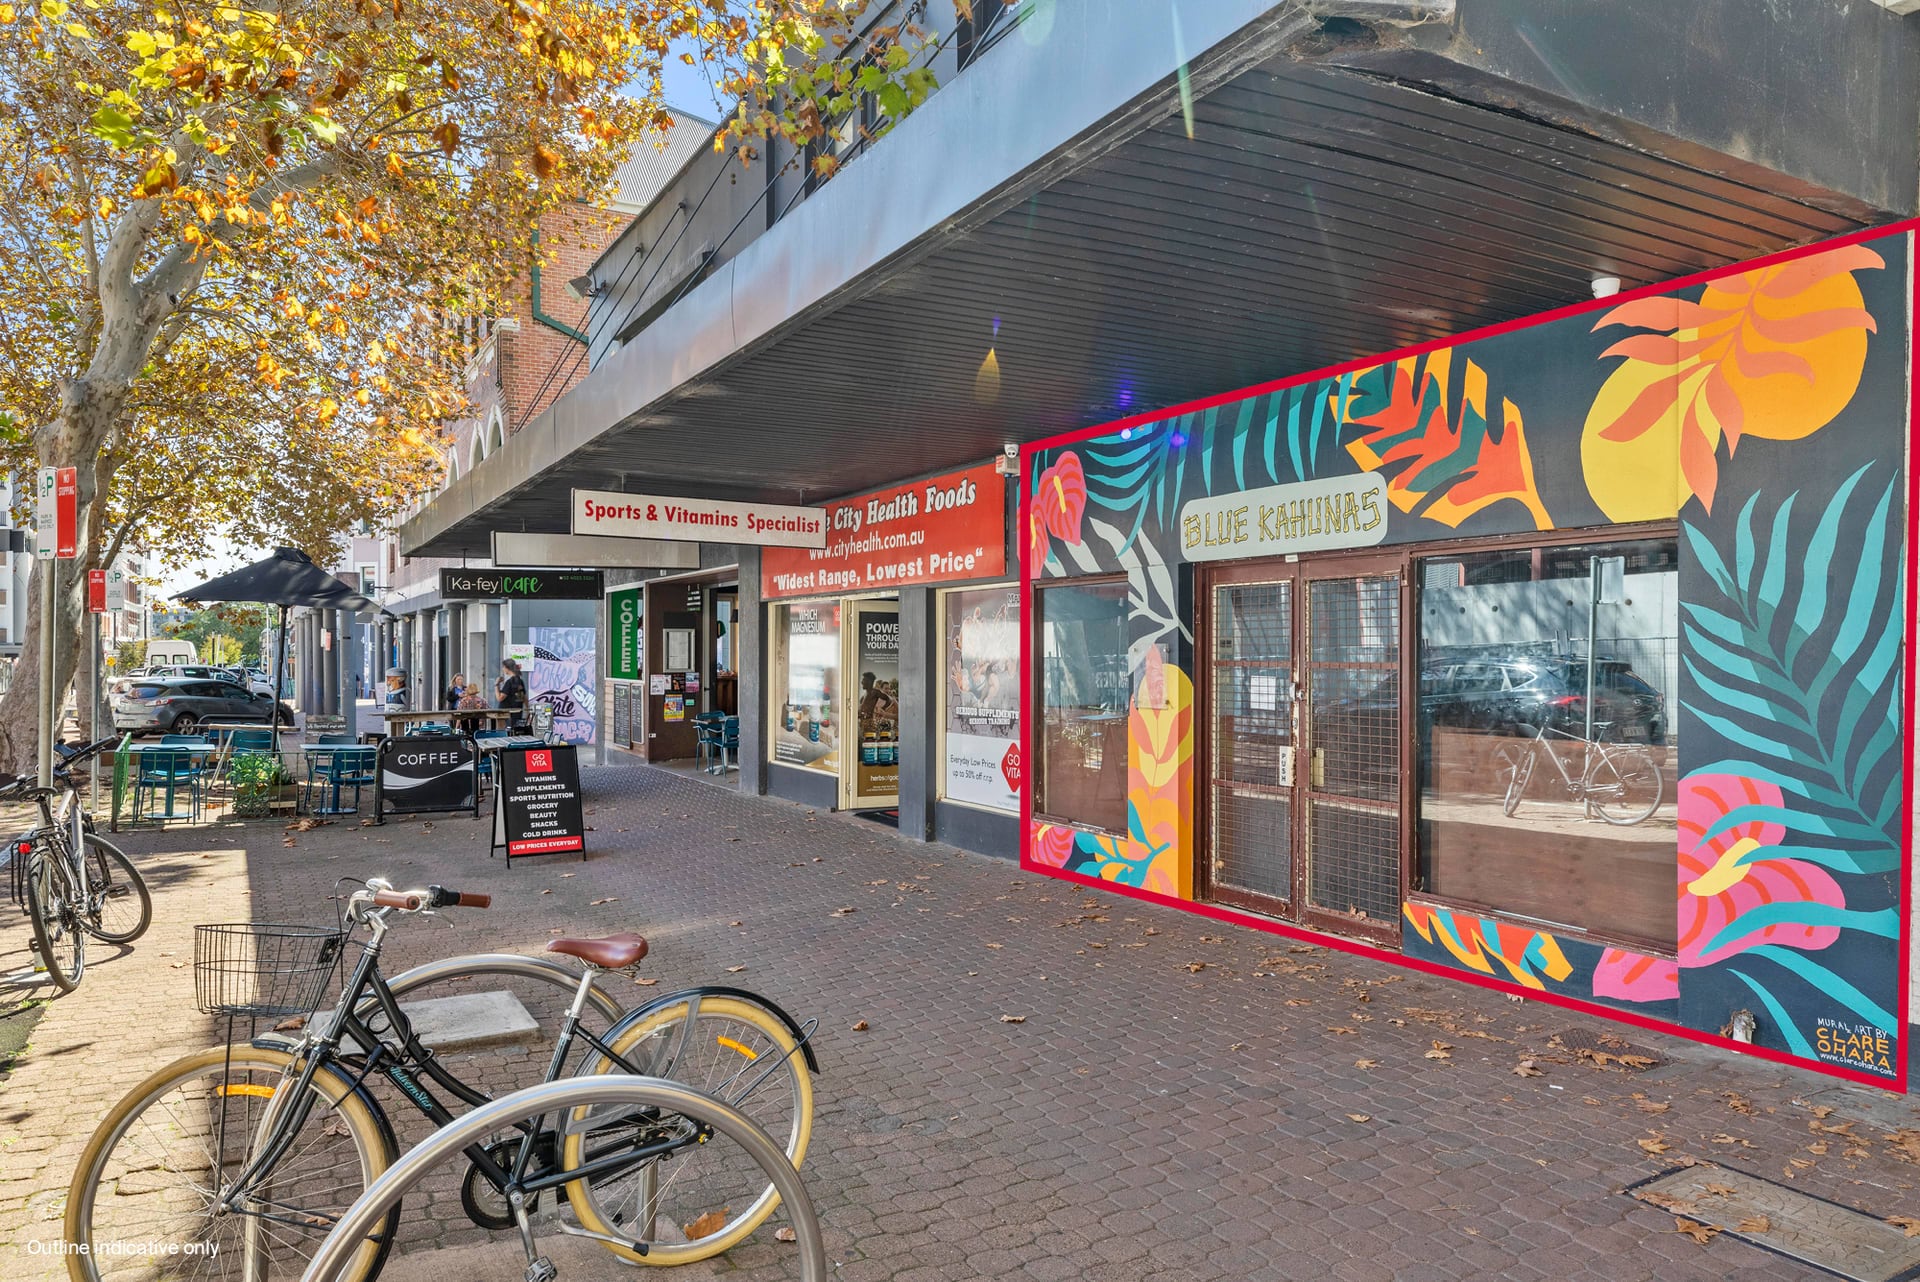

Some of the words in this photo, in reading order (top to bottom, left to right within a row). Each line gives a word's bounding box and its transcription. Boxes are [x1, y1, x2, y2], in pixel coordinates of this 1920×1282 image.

[58, 485, 75, 496] STOPPING
[834, 507, 863, 532] City
[866, 491, 918, 525] Health
[925, 478, 977, 513] Foods
[584, 499, 641, 521] Sports
[646, 503, 659, 521] &
[665, 505, 739, 527] Vitamins
[747, 512, 820, 533] Specialist
[1183, 505, 1249, 549] BLUE
[1257, 487, 1381, 541] KAHUNAS
[809, 530, 925, 561] www.cityhealth.com.au
[818, 568, 861, 588] Range,
[867, 557, 923, 581] Lowest
[799, 609, 818, 620] WHICH
[791, 620, 826, 633] MAGNESIUM
[620, 599, 633, 672] COFFEE
[866, 641, 887, 649] YOUR
[978, 708, 1020, 719] SUPPLEMENTS
[397, 752, 459, 765] COFFEE
[950, 754, 970, 768] Everyday
[970, 757, 981, 766] Low
[981, 758, 996, 769] Prices
[1007, 754, 1020, 766] GO
[952, 770, 959, 780] up
[975, 772, 983, 781] off
[1006, 767, 1020, 778] VITA
[524, 775, 557, 783] VITAMINS
[516, 784, 566, 792] SUPPLEMENTS
[509, 794, 537, 802] SPORTS
[537, 792, 574, 800] NUTRITION
[526, 802, 559, 810] GROCERY
[529, 811, 557, 819] BEAUTY
[530, 820, 558, 828] SNACKS
[522, 830, 541, 838] COLD
[542, 829, 567, 837] DRINKS
[526, 841, 548, 849] PRICES
[548, 839, 579, 848] EVERYDAY
[1817, 1017, 1852, 1034] MURAL
[1854, 1024, 1873, 1037] ART
[1875, 1028, 1888, 1040] BY
[1816, 1027, 1890, 1055] CLARE
[1817, 1039, 1891, 1070] OHARA
